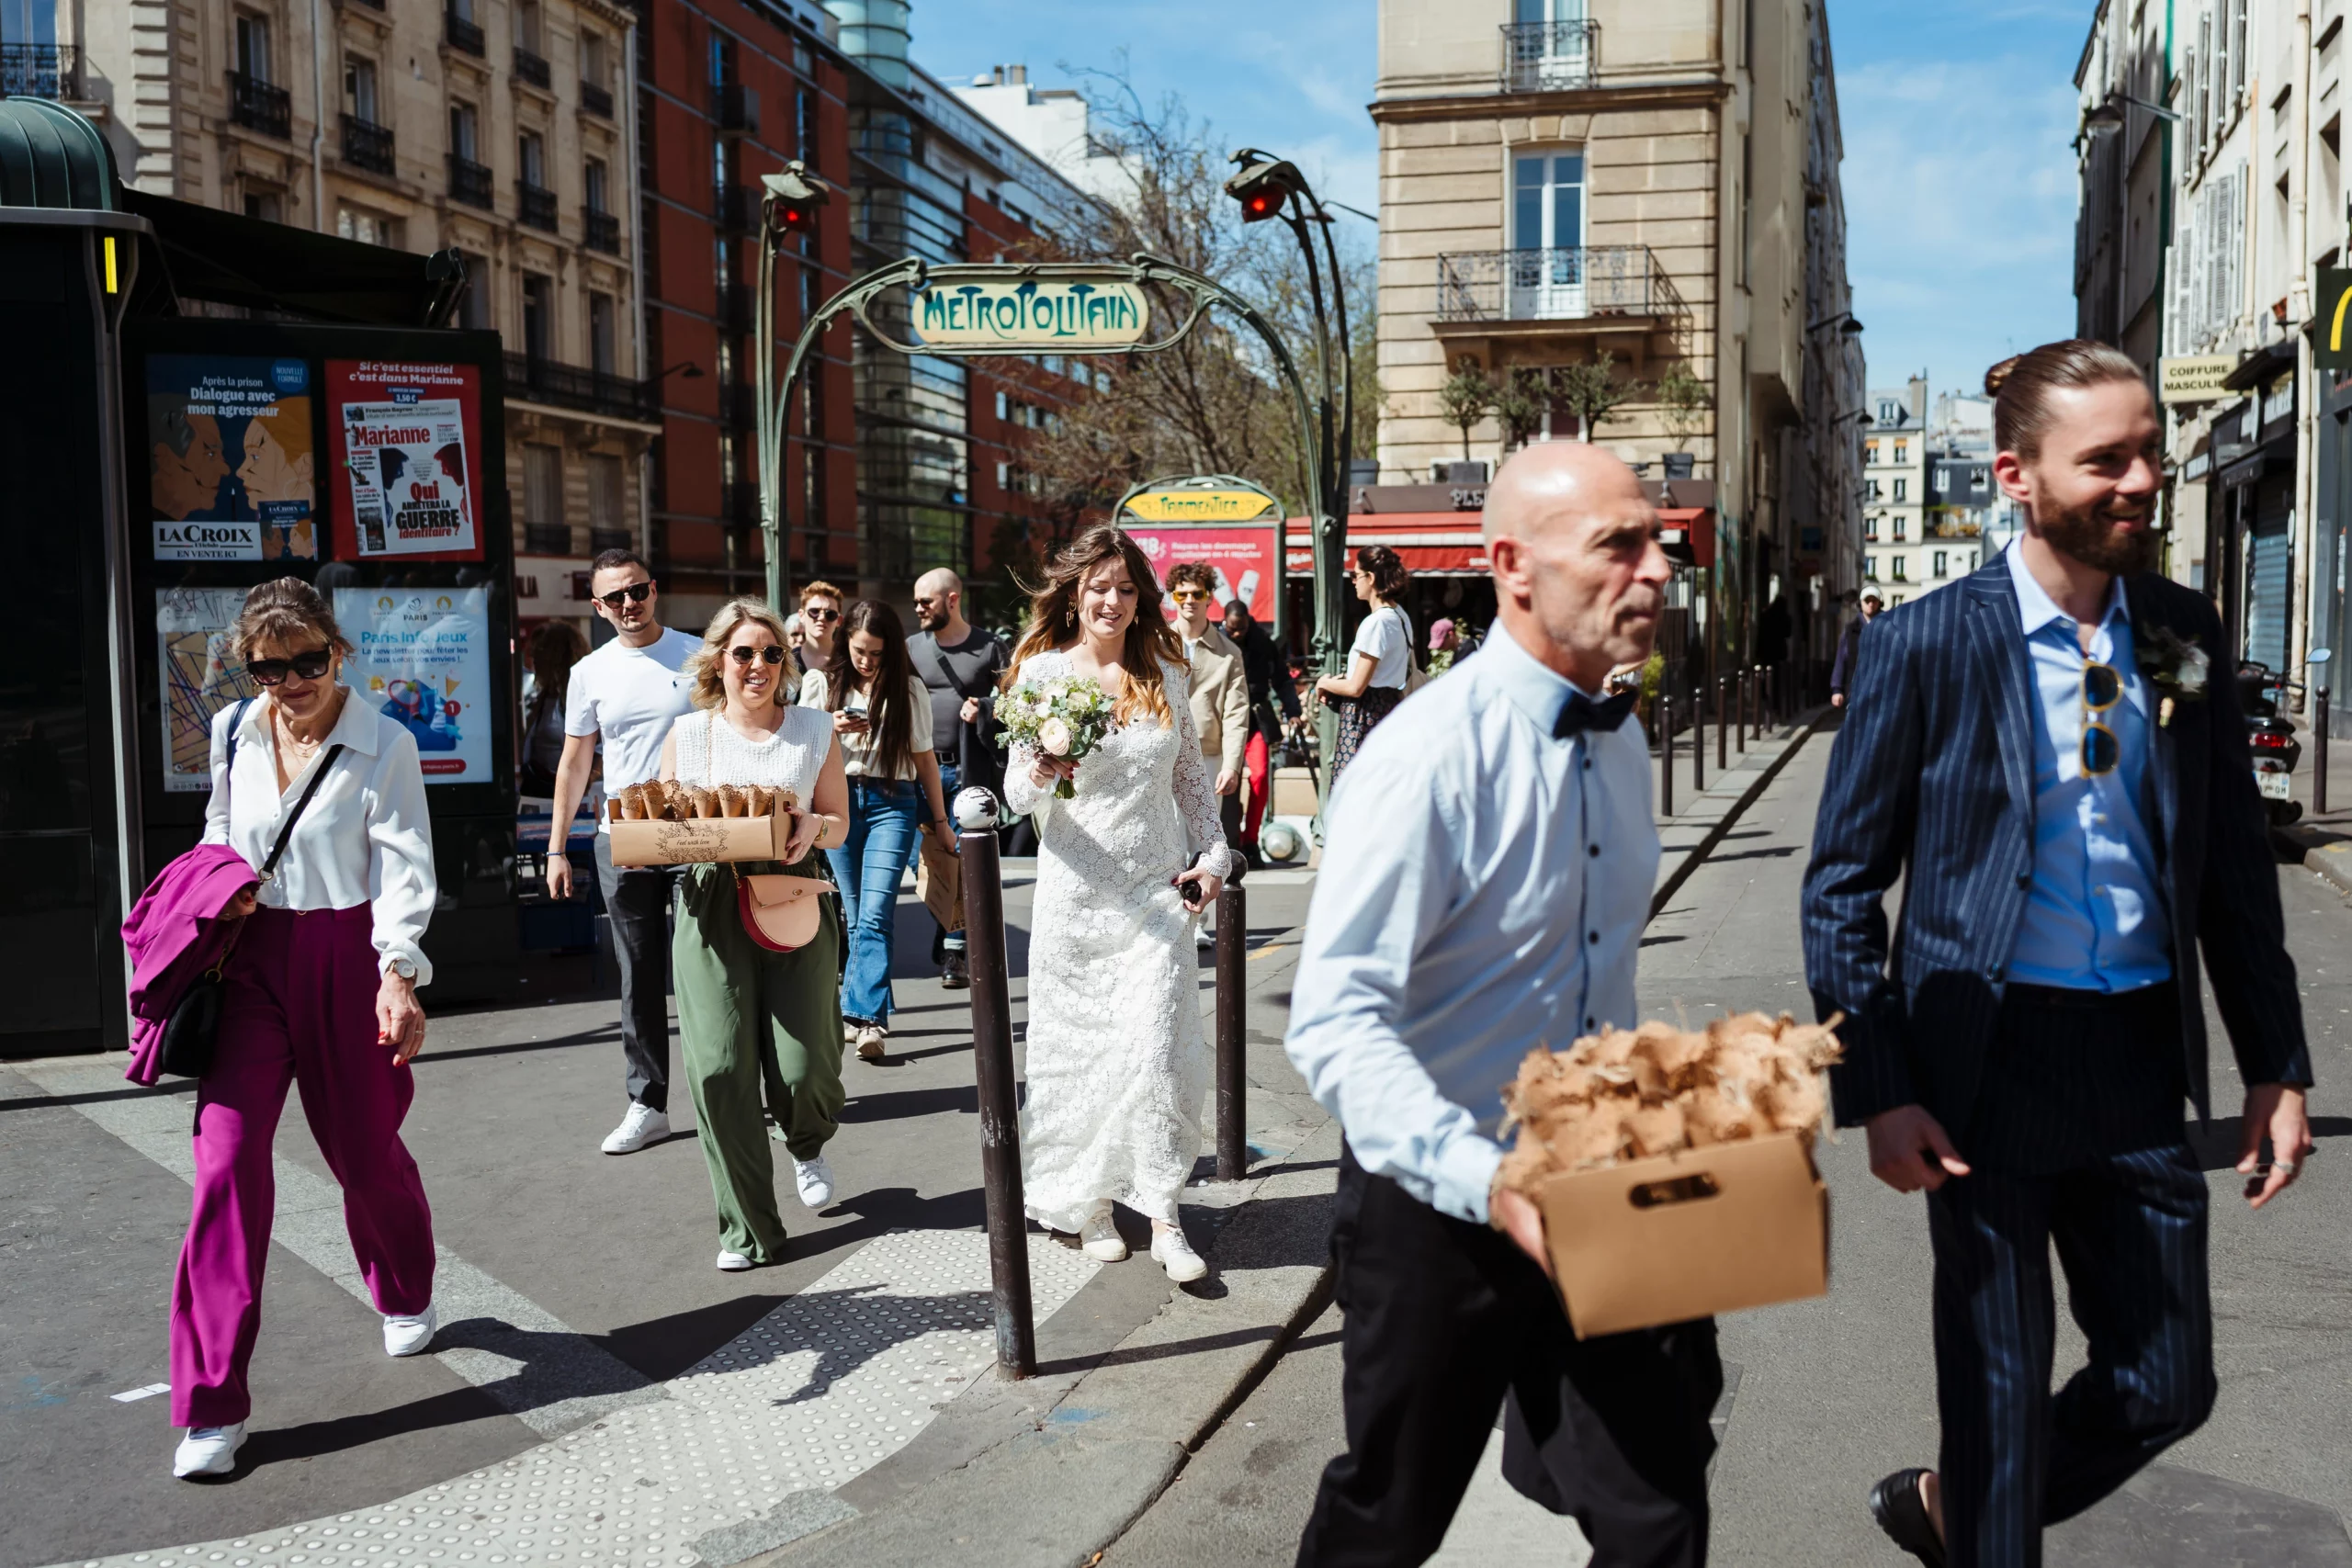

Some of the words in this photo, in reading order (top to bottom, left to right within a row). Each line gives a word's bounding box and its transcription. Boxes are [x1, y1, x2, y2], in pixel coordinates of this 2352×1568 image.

[924, 280, 1138, 339] METROPOLITAIN
[359, 362, 370, 371] Si
[401, 365, 453, 374] essentiel
[2169, 364, 2229, 377] COIFFURE
[202, 376, 226, 387] Après
[228, 377, 235, 386] la
[237, 377, 263, 388] prison
[277, 375, 302, 383] FORMULE
[379, 373, 408, 383] dans
[410, 374, 463, 385] Marianne
[190, 387, 244, 403] Dialogue
[247, 392, 276, 401] avec
[187, 404, 215, 415] mon
[218, 405, 279, 418] agresseur
[356, 423, 431, 447] Marianne
[410, 479, 440, 502] Qui
[441, 500, 451, 509] LA
[1160, 496, 1242, 518] PARMENTIER
[395, 509, 460, 529] GUERRE
[189, 550, 221, 558] VENTE
[361, 631, 399, 644] Paris
[401, 630, 429, 643] Info
[435, 632, 468, 643] Jeux
[436, 646, 455, 654] fêter
[457, 646, 468, 654] les
[449, 703, 455, 714] 1
